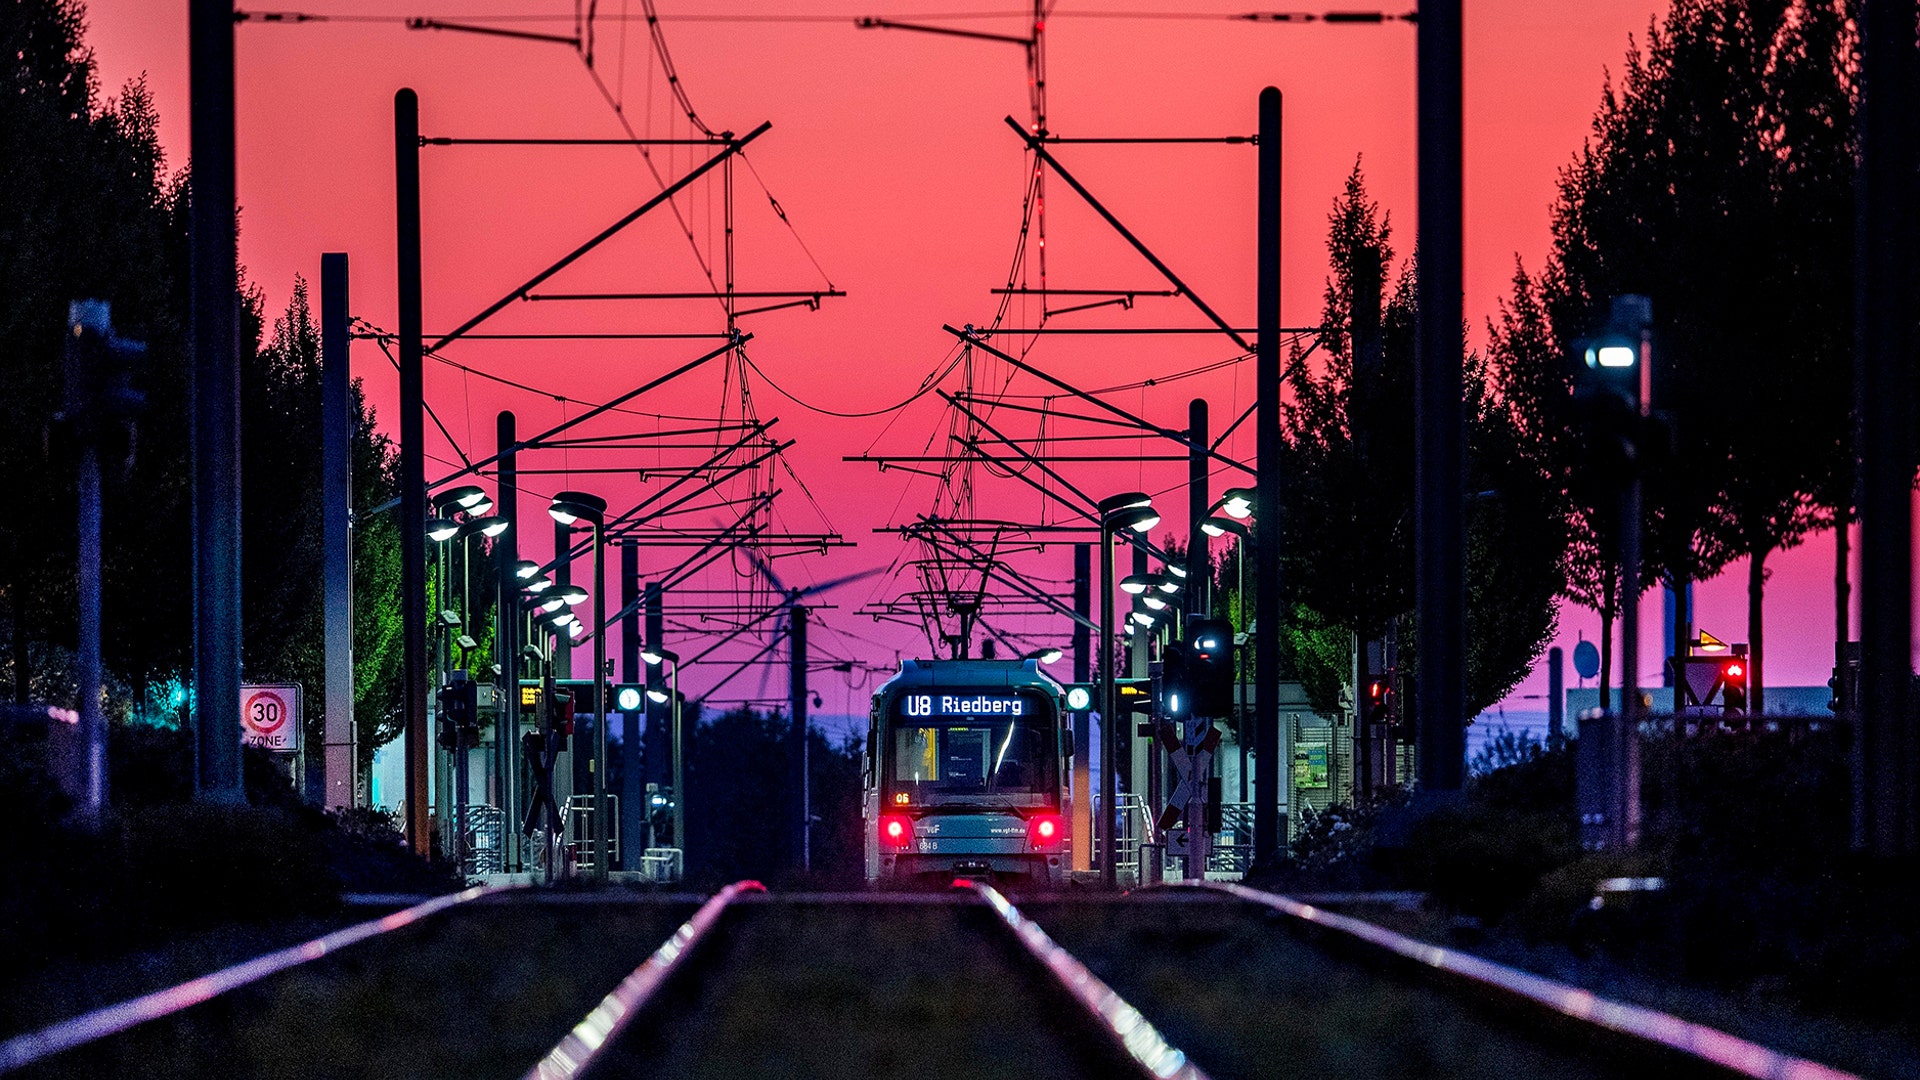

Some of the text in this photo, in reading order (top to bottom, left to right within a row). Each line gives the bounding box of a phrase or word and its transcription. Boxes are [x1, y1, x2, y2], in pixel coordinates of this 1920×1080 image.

[253, 703, 278, 722] 30
[908, 695, 1022, 716] U8 Riedberg
[250, 736, 281, 746] ZONE
[896, 793, 909, 804] 06
